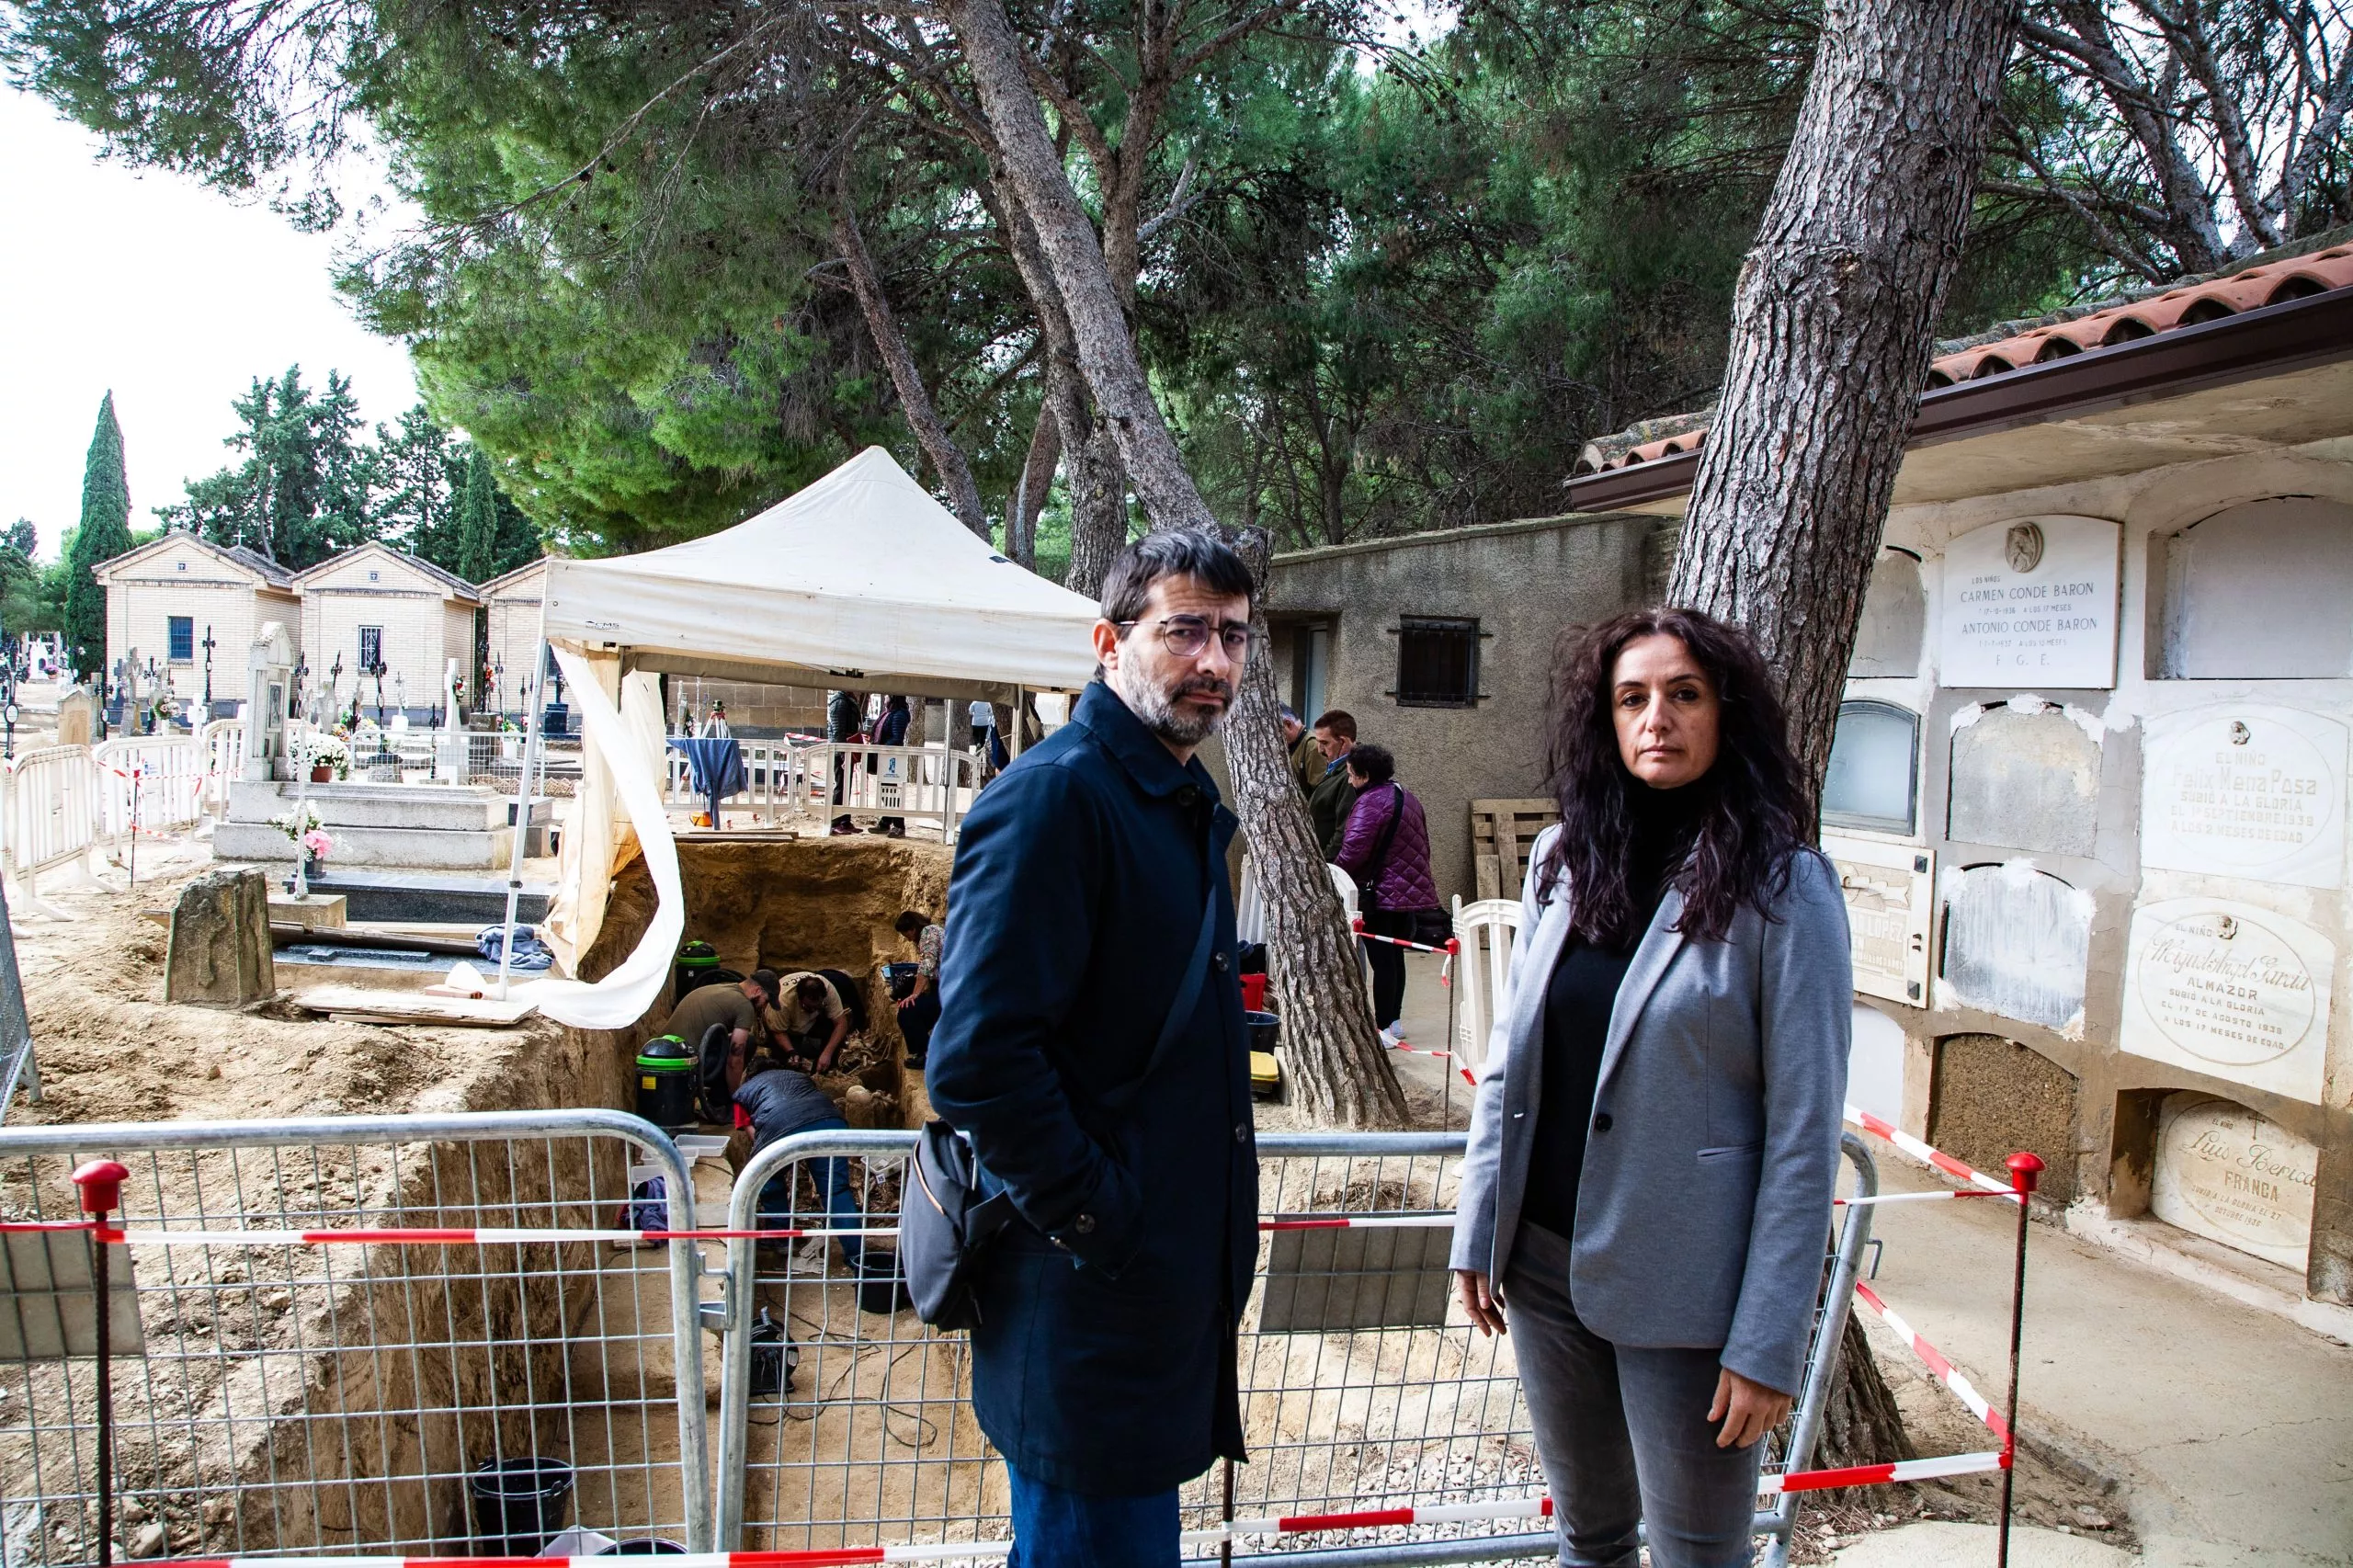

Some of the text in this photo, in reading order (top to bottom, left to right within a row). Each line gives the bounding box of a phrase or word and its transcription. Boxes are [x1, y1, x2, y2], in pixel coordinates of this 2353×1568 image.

[1961, 582, 2095, 603] CARMEN CONDE BARON
[2052, 604, 2072, 612] MESES
[1961, 618, 2097, 635] ANTONIO CONDE BARON
[2215, 752, 2232, 765] EL
[2171, 805, 2185, 817] EL
[2220, 793, 2228, 806] A
[2234, 794, 2250, 808] LA
[2256, 796, 2302, 812] GLORIA
[2171, 820, 2178, 832] A
[2181, 821, 2202, 834] LOS
[2217, 824, 2255, 839] MESES
[2257, 827, 2271, 840] DE
[2273, 830, 2302, 844] EDAD
[2176, 923, 2186, 932] EL
[2187, 976, 2258, 1001] ALMAZOR
[2161, 1000, 2173, 1009] EL
[2179, 1005, 2189, 1013] 17
[2195, 1008, 2207, 1017] DE
[2212, 1012, 2252, 1028] AGOSTO
[2200, 994, 2207, 1003] A
[2210, 997, 2222, 1007] LA
[2226, 1000, 2265, 1017] GLORIA
[2163, 1015, 2169, 1023] A
[2174, 1017, 2191, 1028] LOS
[2197, 1023, 2206, 1031] 17
[2211, 1026, 2243, 1040] MESES
[2246, 1035, 2258, 1044] DE
[2211, 1118, 2219, 1126] EL
[2184, 1131, 2230, 1162] Luis
[2214, 1206, 2245, 1221] OCTUBRE
[2221, 1195, 2230, 1204] LA
[2231, 1199, 2256, 1213] GLORIA
[2258, 1208, 2268, 1217] EL
[2270, 1211, 2281, 1221] 27
